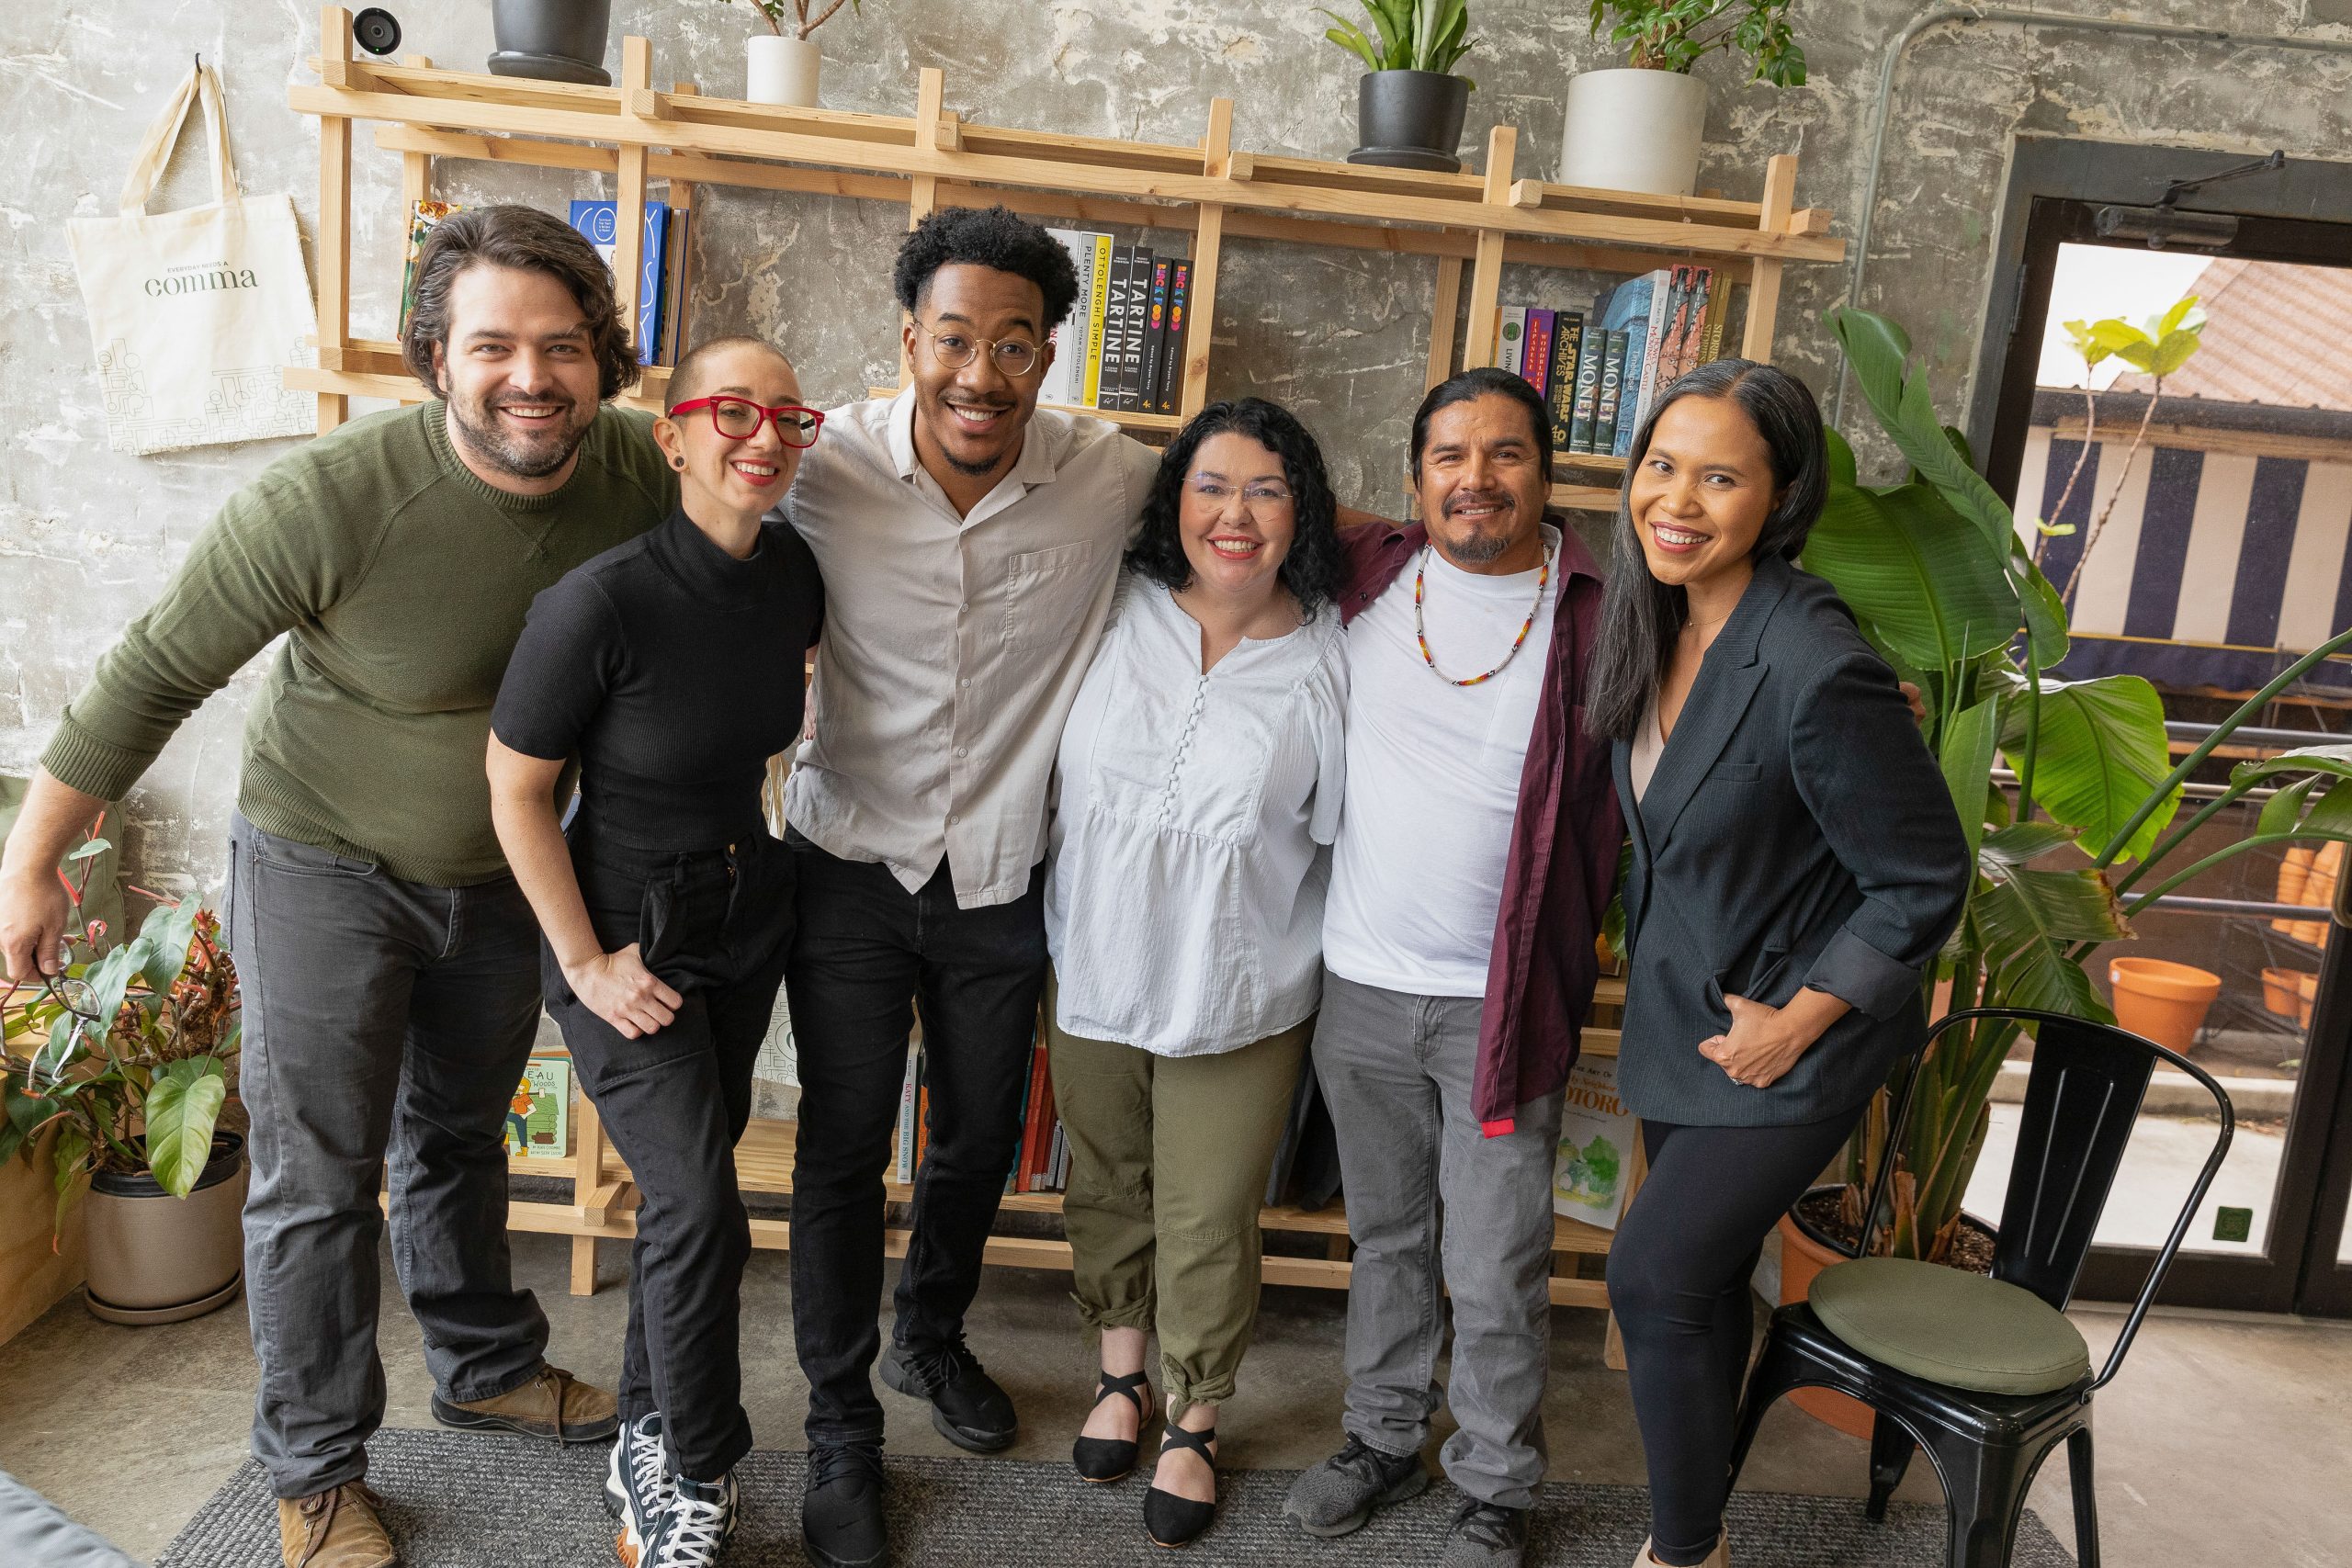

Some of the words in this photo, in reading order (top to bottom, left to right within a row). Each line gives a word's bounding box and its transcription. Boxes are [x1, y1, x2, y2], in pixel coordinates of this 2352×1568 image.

[144, 269, 258, 297] comma
[167, 265, 200, 274] EVERYDAY
[201, 261, 221, 269] NEEDS
[1082, 246, 1092, 285] PLENTY
[1094, 247, 1106, 318] OTTOLENGHI
[1154, 264, 1167, 295] BLACK
[1174, 265, 1187, 297] BLACK
[1080, 289, 1088, 318] MORE
[1104, 278, 1127, 364] TARTINE
[1125, 278, 1148, 364] TARTINE
[1151, 297, 1163, 330] FOOD
[1170, 299, 1183, 331] FOOD
[1090, 322, 1100, 360] SIMPLE
[1529, 321, 1539, 370] JAPANESE
[1555, 325, 1569, 377] ARCHIVES
[1569, 326, 1580, 343] THE
[1645, 326, 1657, 361] MOVING
[1699, 324, 1712, 362] STORIES
[1709, 323, 1723, 362] STORIES
[1536, 333, 1548, 389] WOODBLOCK
[1565, 343, 1578, 383] STAR
[1627, 351, 1641, 391] Timelapse
[1641, 363, 1652, 392] CASTLE
[1559, 383, 1573, 423] WARS
[1577, 353, 1599, 422] MONET
[1598, 356, 1621, 424] MONET
[901, 1146, 910, 1169] SNOW
